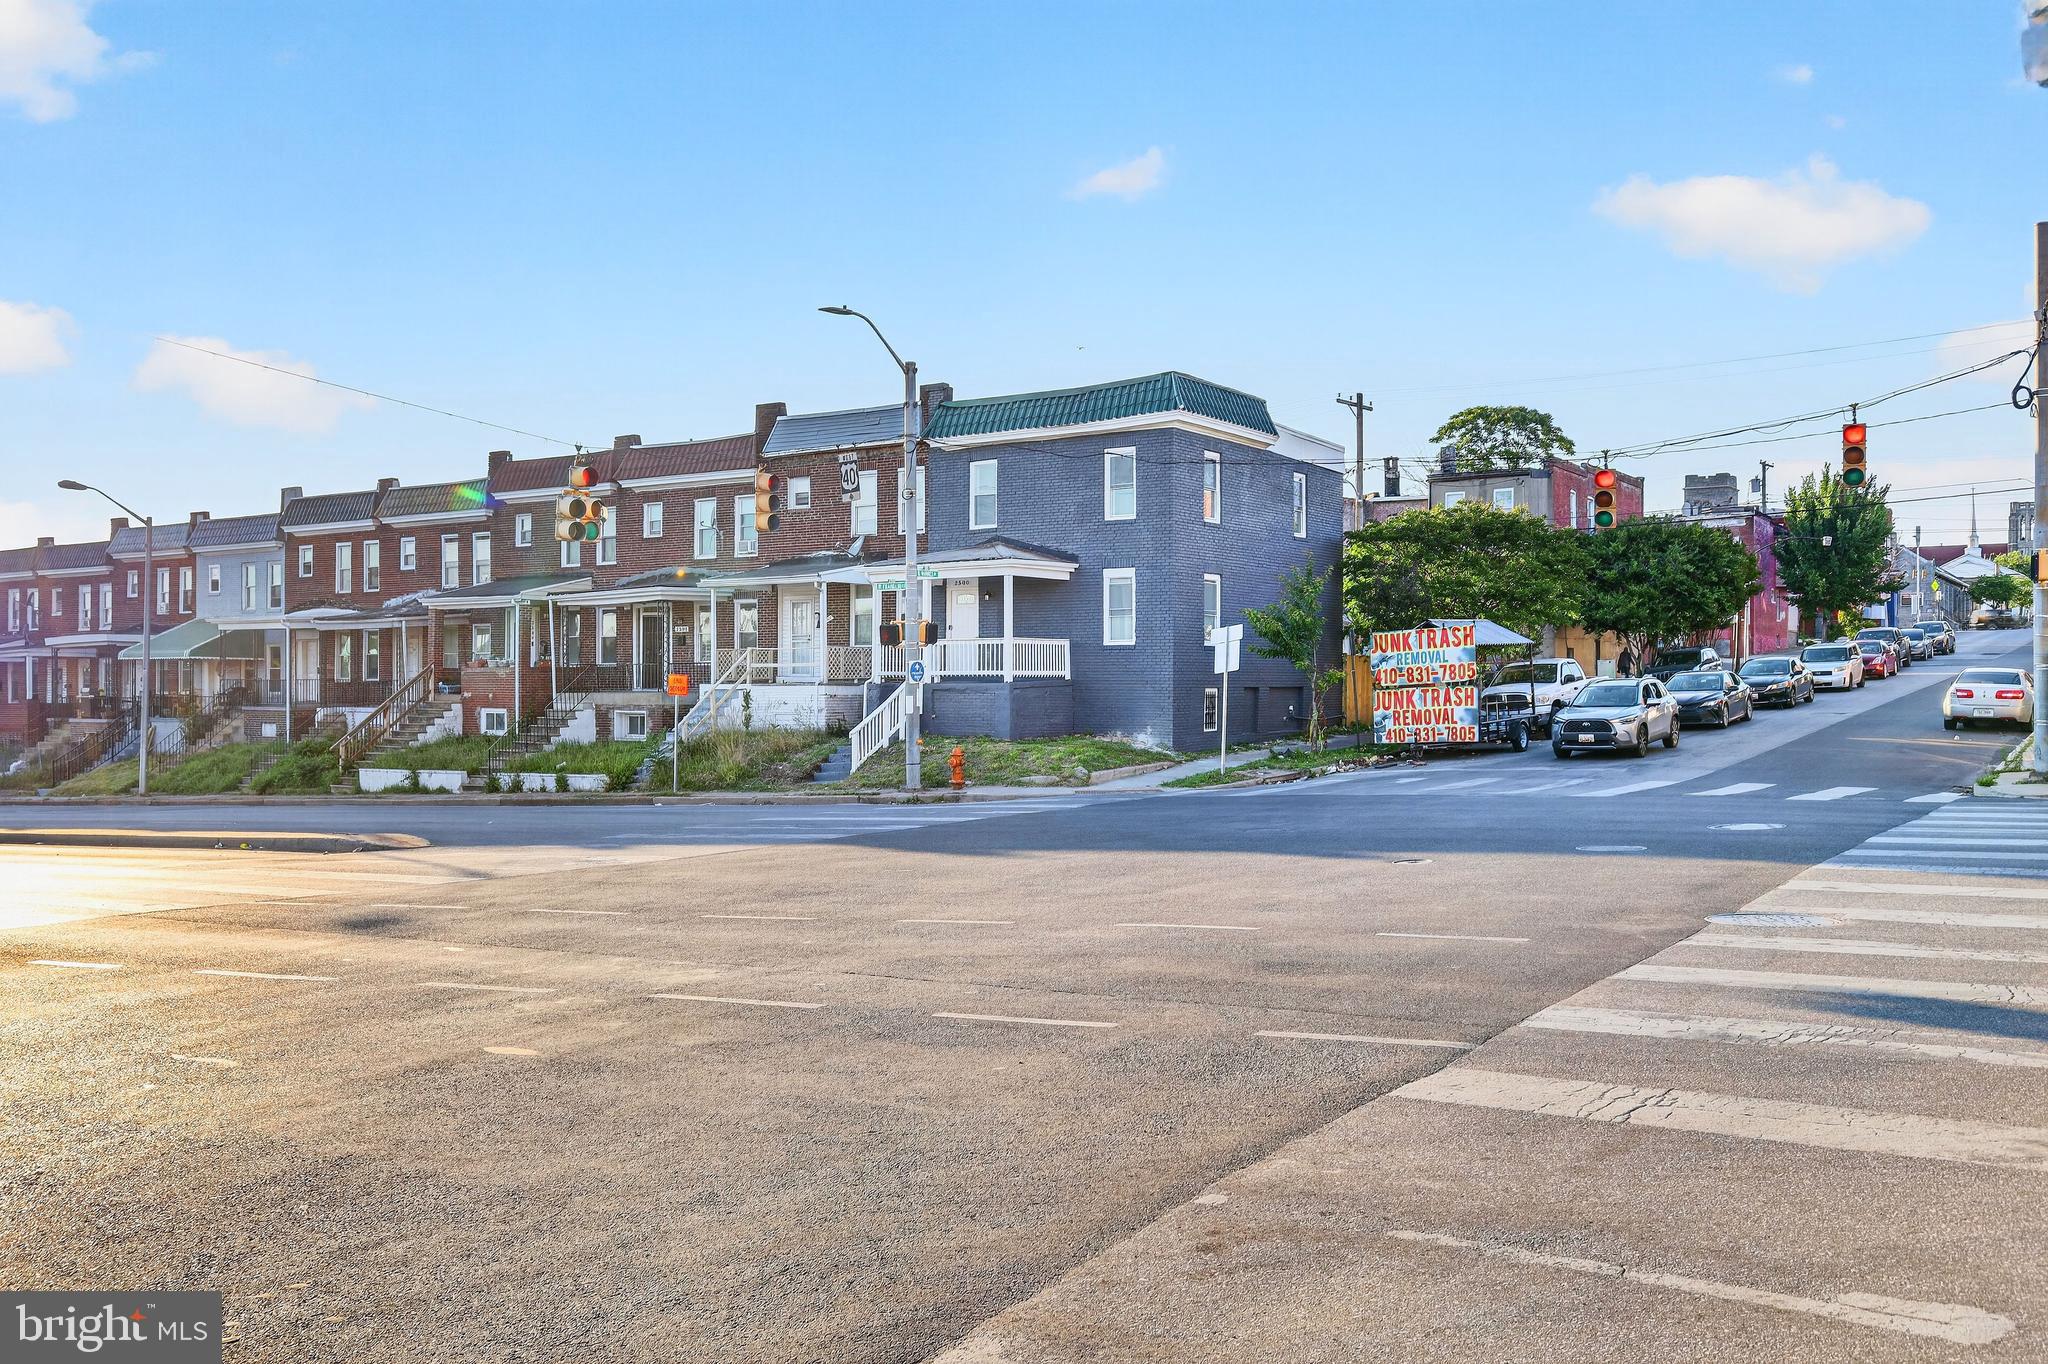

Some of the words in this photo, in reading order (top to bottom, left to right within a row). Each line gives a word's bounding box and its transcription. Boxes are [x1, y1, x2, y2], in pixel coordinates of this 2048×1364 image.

[843, 468, 856, 485] 40
[1372, 632, 1413, 654] JUNK
[1415, 624, 1475, 649] TRASH
[1396, 649, 1449, 666] REMOVAL
[1375, 663, 1476, 684] 410-831-7805
[1374, 689, 1417, 711] JUNK
[1420, 687, 1475, 707] TRASH
[1392, 708, 1458, 726] REMOVAL
[1385, 726, 1476, 743] 410-831-7805
